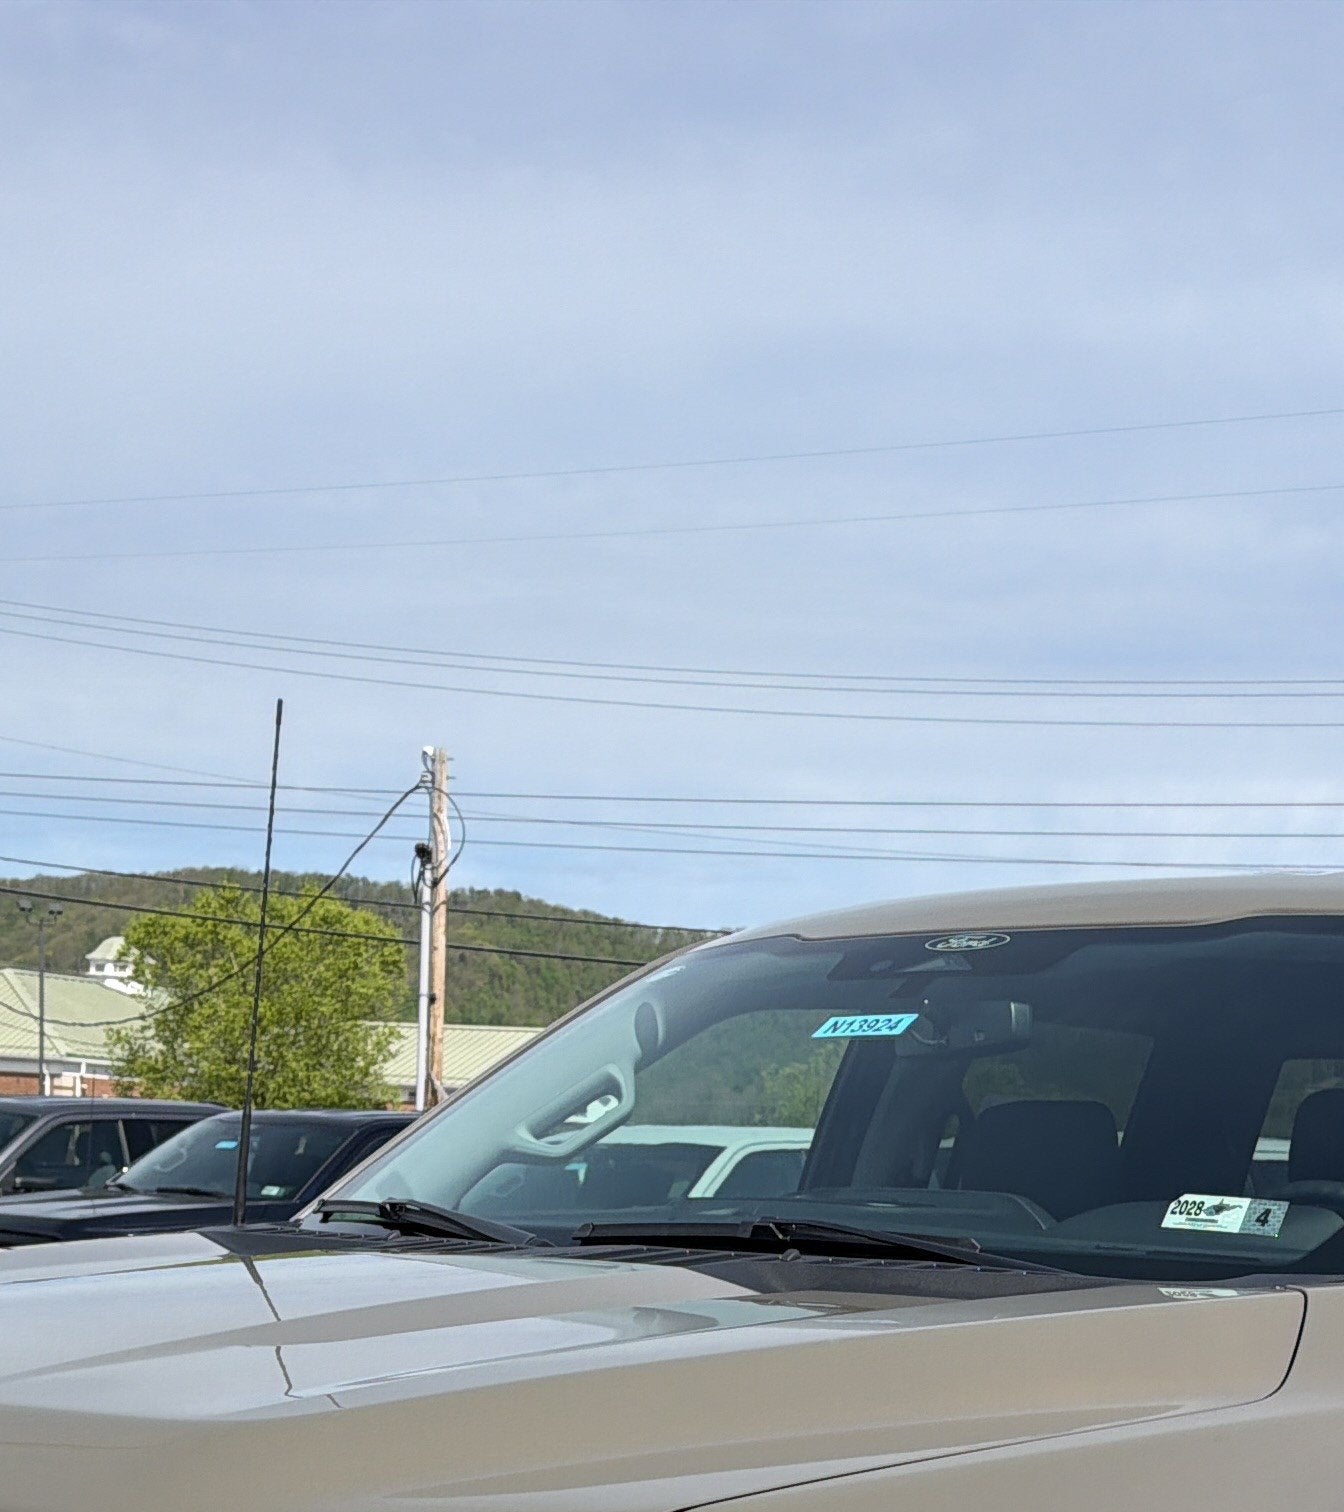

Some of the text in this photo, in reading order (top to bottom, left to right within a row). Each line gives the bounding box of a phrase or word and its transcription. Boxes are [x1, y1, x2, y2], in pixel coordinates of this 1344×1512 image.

[824, 1016, 903, 1035] N13924
[1169, 1199, 1273, 1228] 2028 4
